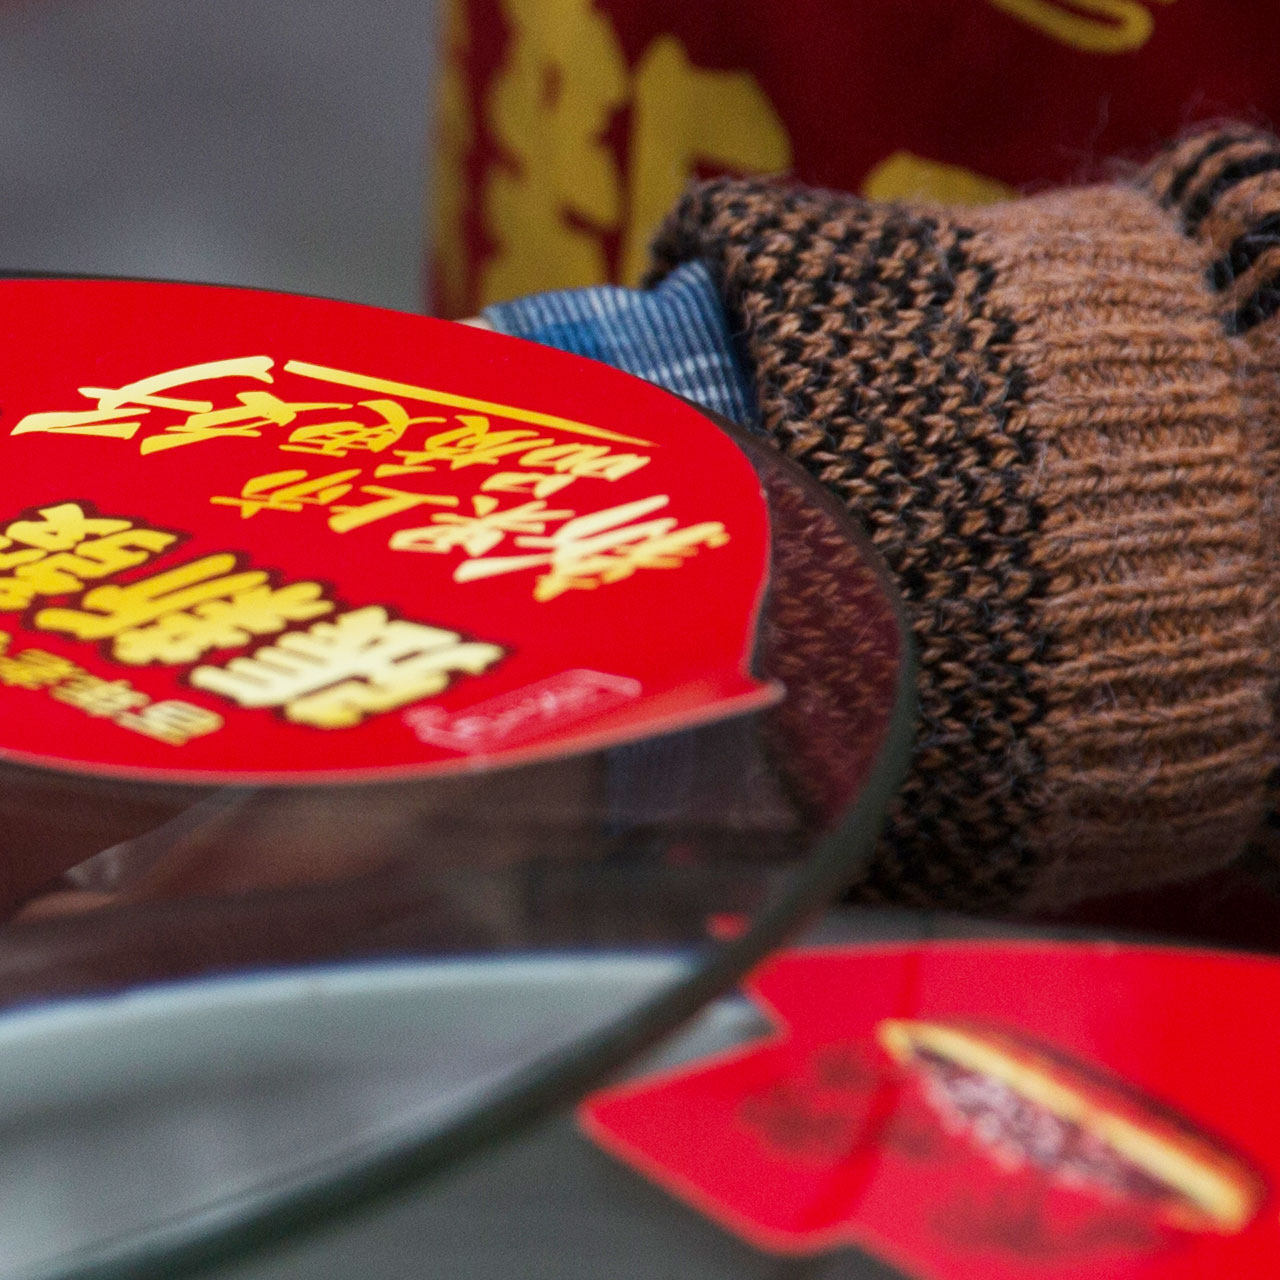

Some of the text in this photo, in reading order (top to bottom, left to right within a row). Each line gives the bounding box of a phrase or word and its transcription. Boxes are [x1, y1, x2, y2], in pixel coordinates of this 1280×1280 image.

[10, 356, 649, 499] 品质更好
[207, 468, 729, 602] 新果上市
